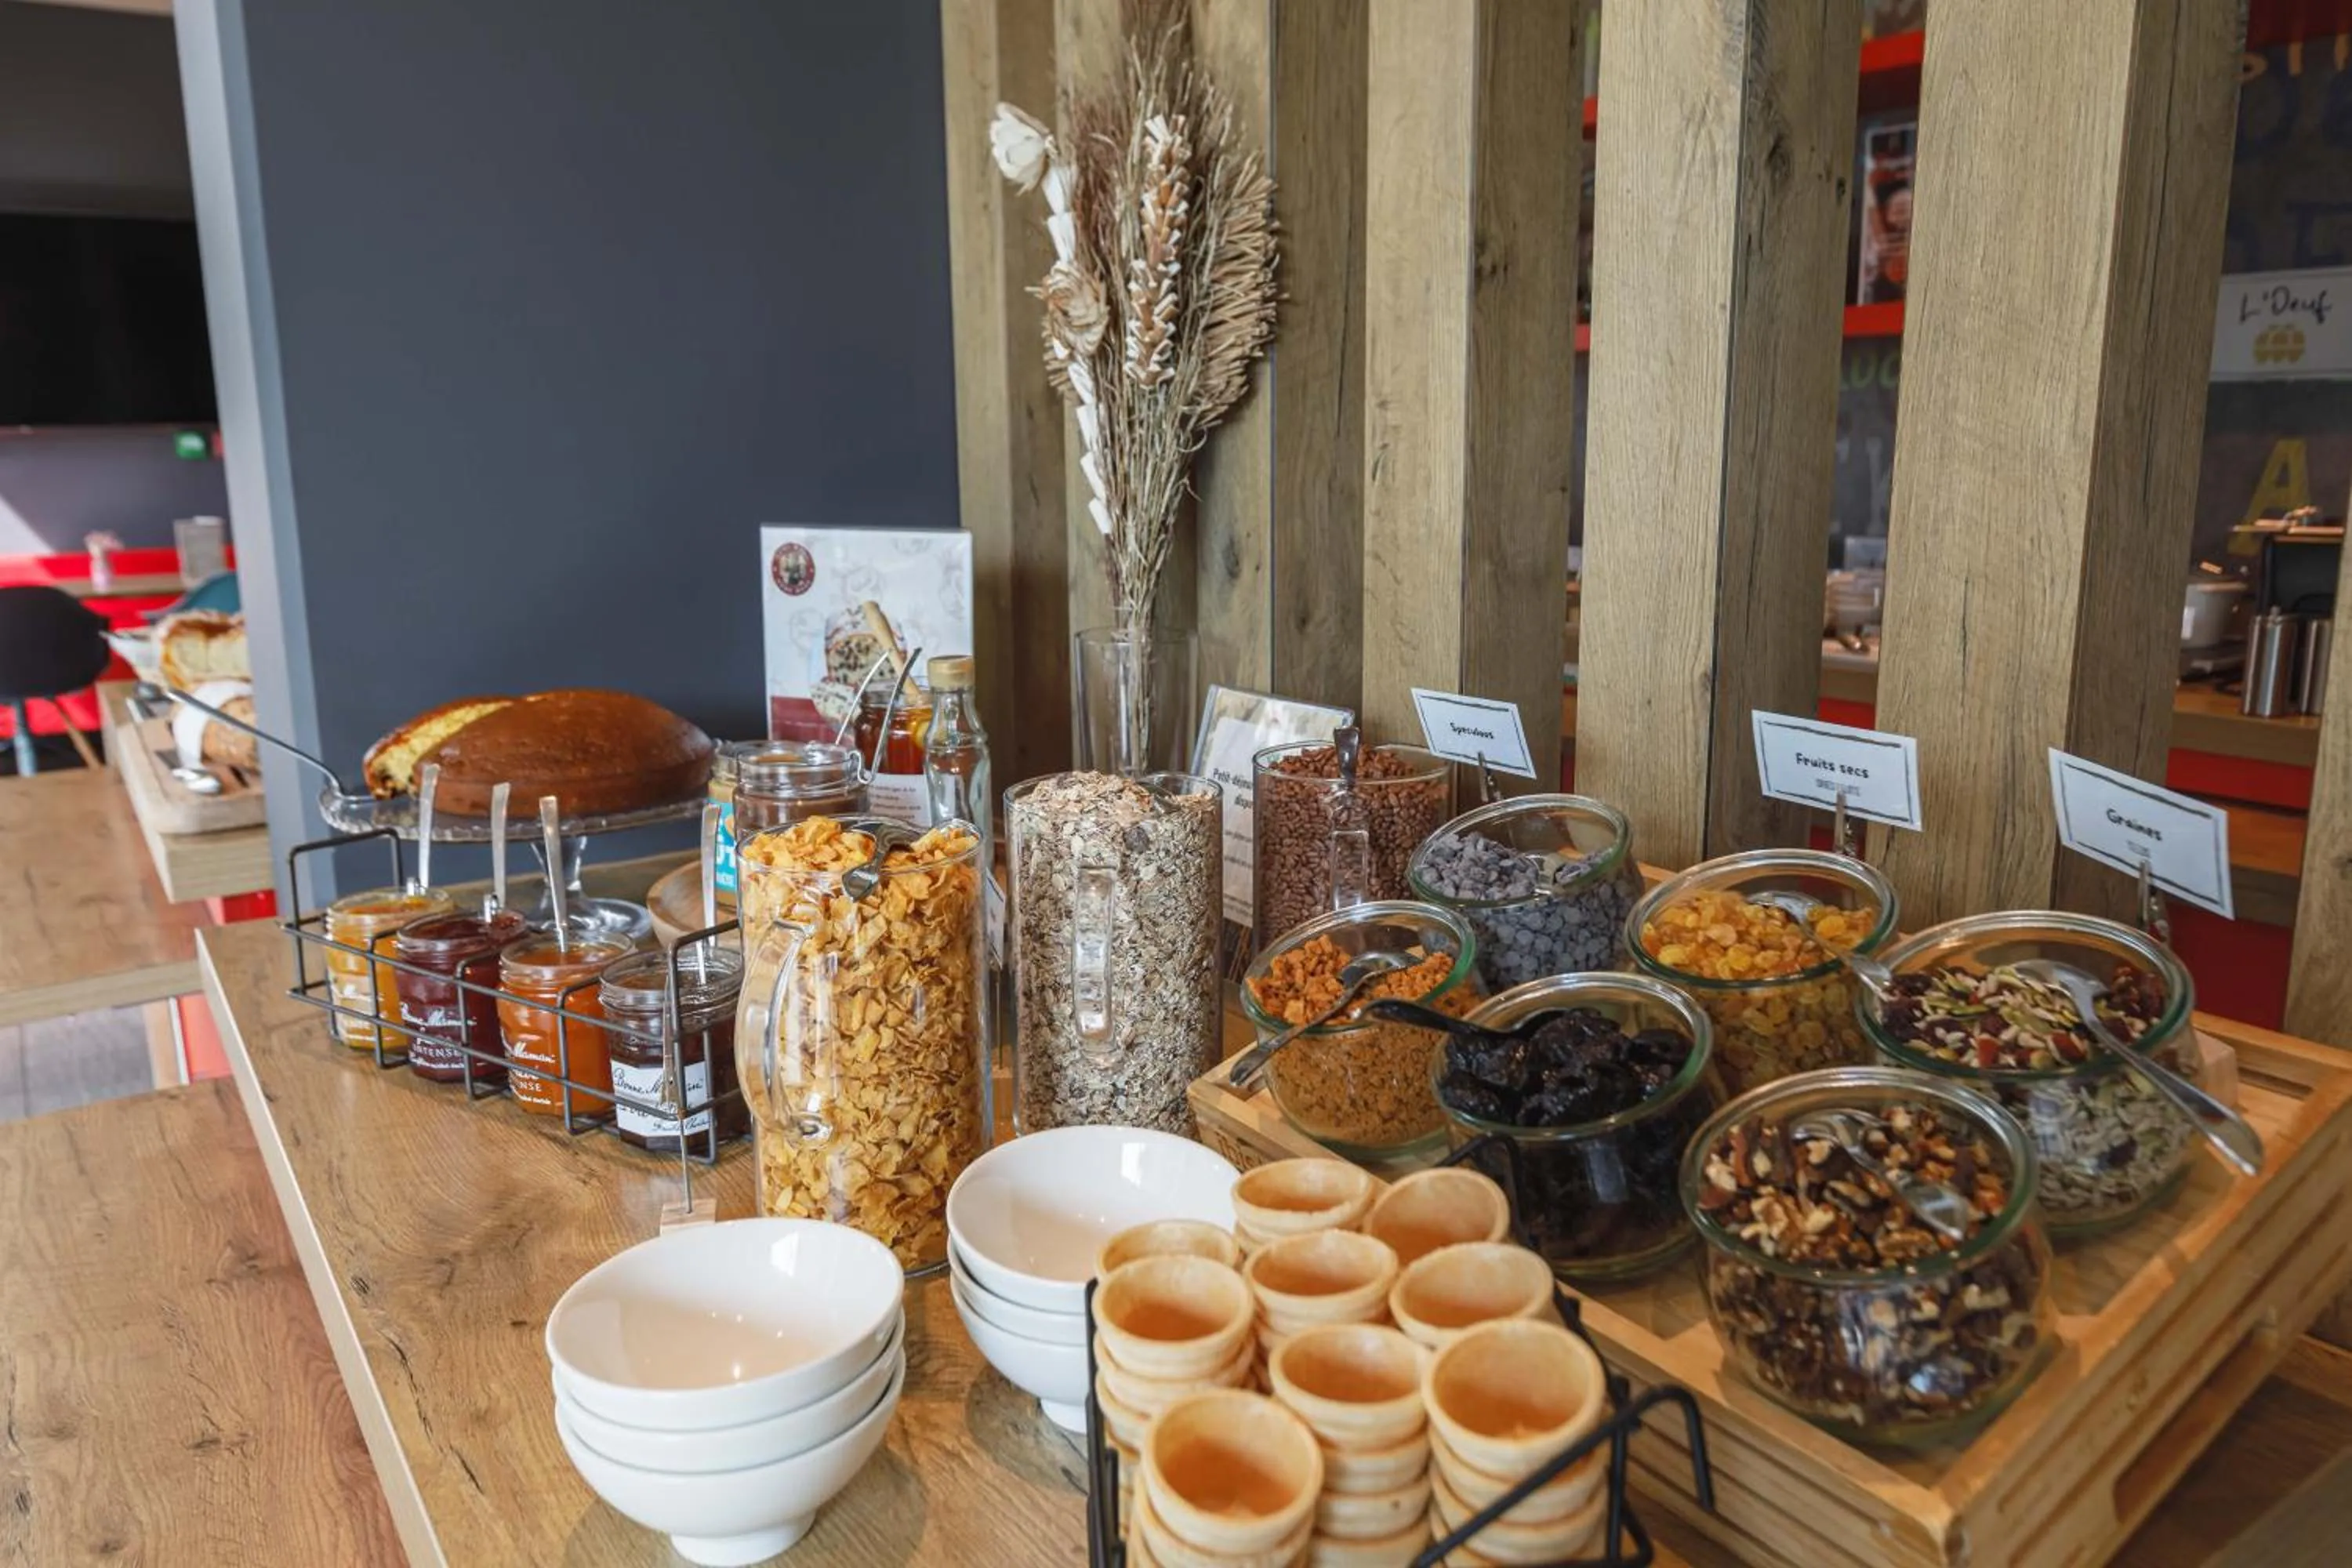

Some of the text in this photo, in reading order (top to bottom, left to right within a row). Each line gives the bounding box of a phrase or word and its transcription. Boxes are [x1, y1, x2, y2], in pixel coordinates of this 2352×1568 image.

[1795, 752, 1869, 779] Fruits secs
[2105, 808, 2162, 841] Graines
